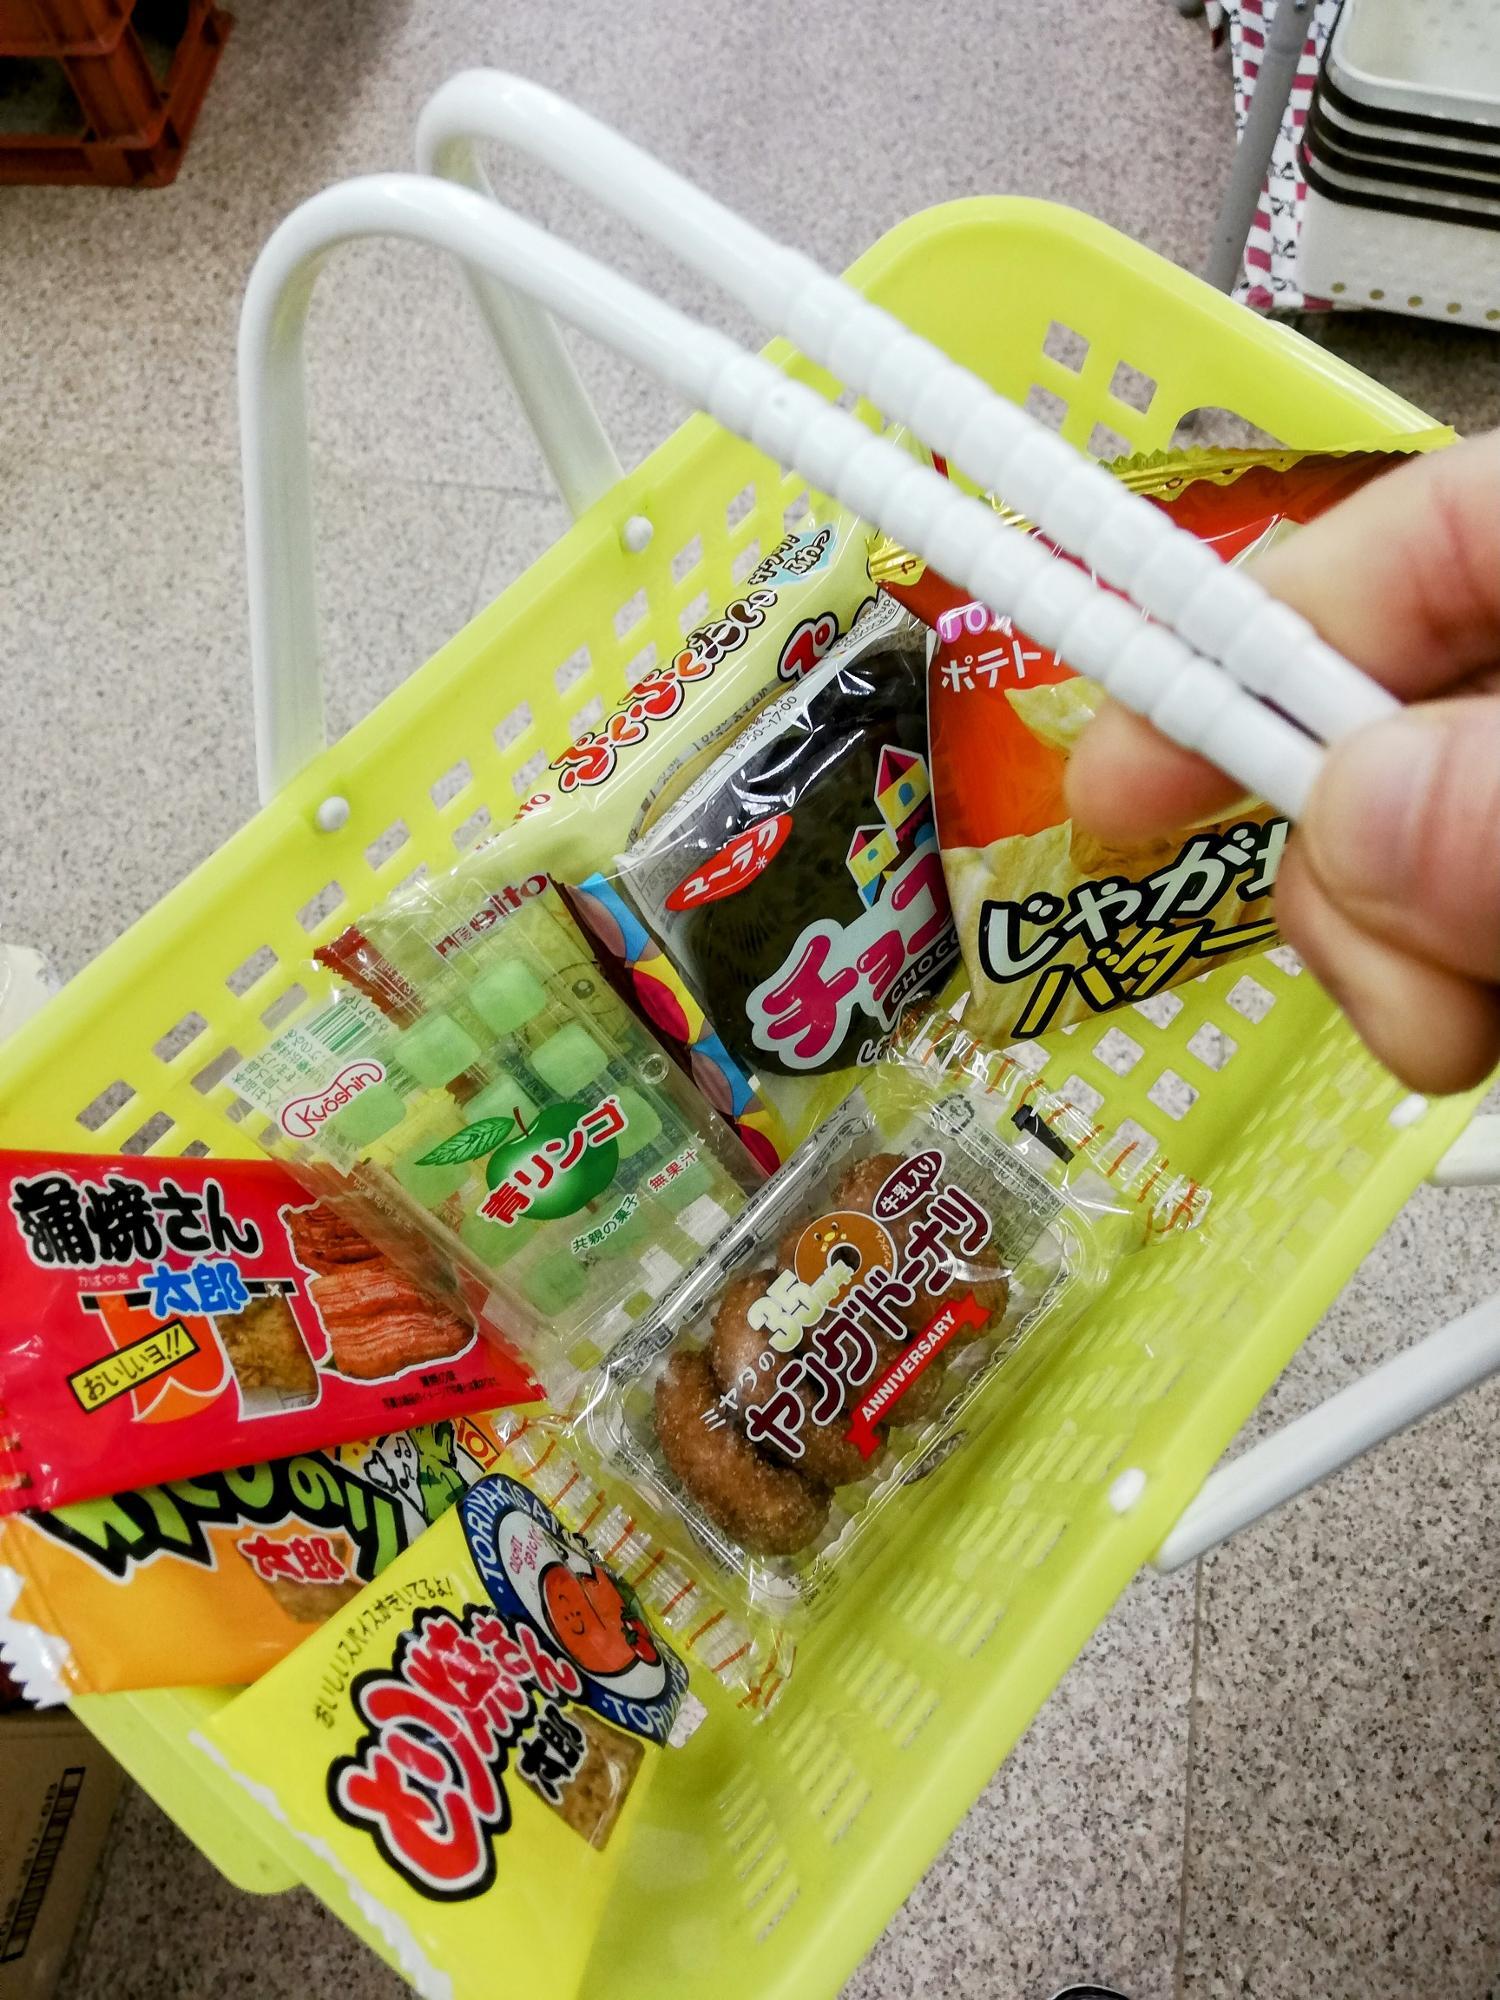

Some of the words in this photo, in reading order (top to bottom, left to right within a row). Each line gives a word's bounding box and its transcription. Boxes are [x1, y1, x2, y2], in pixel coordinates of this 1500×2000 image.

[550, 589, 778, 793] ぷくぷくたい
[681, 819, 779, 905] ユーラク
[762, 853, 958, 1060] チョコ
[480, 1097, 627, 1226] 青リンゴ
[649, 1147, 698, 1192] 無果汁
[880, 1155, 937, 1213] 牛乳入り
[11, 1176, 261, 1266] 蒲焼さん
[143, 1262, 250, 1316] 太郎
[746, 1185, 992, 1458] ヤングドーナツ
[700, 1350, 777, 1433] ミヤタの
[861, 1310, 957, 1422] ANNIVERSARY
[238, 1535, 348, 1584] 太郎
[519, 1704, 586, 1804] 太郎
